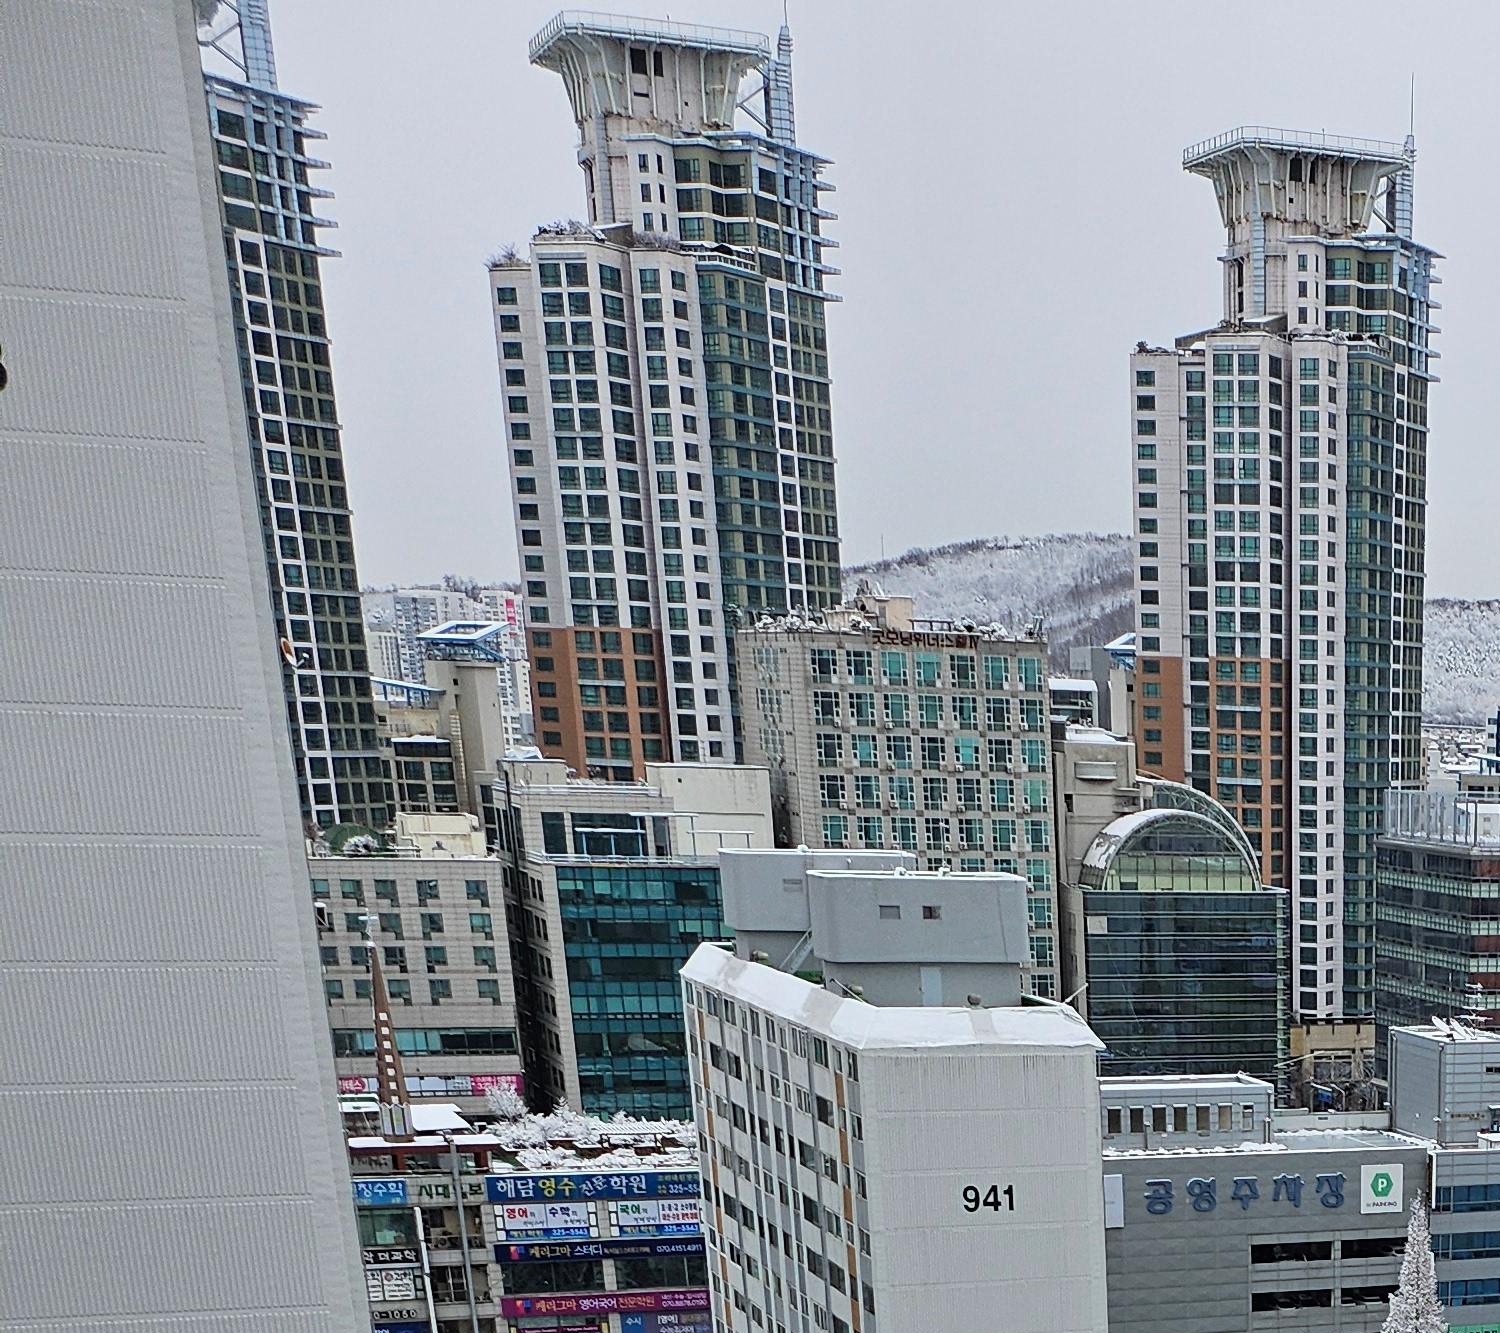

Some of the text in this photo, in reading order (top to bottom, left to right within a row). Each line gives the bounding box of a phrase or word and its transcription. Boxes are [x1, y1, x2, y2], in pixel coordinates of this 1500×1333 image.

[962, 1184, 1016, 1213] 941
[1144, 1171, 1348, 1215] 공영주차장
[573, 1244, 603, 1255] 스터디
